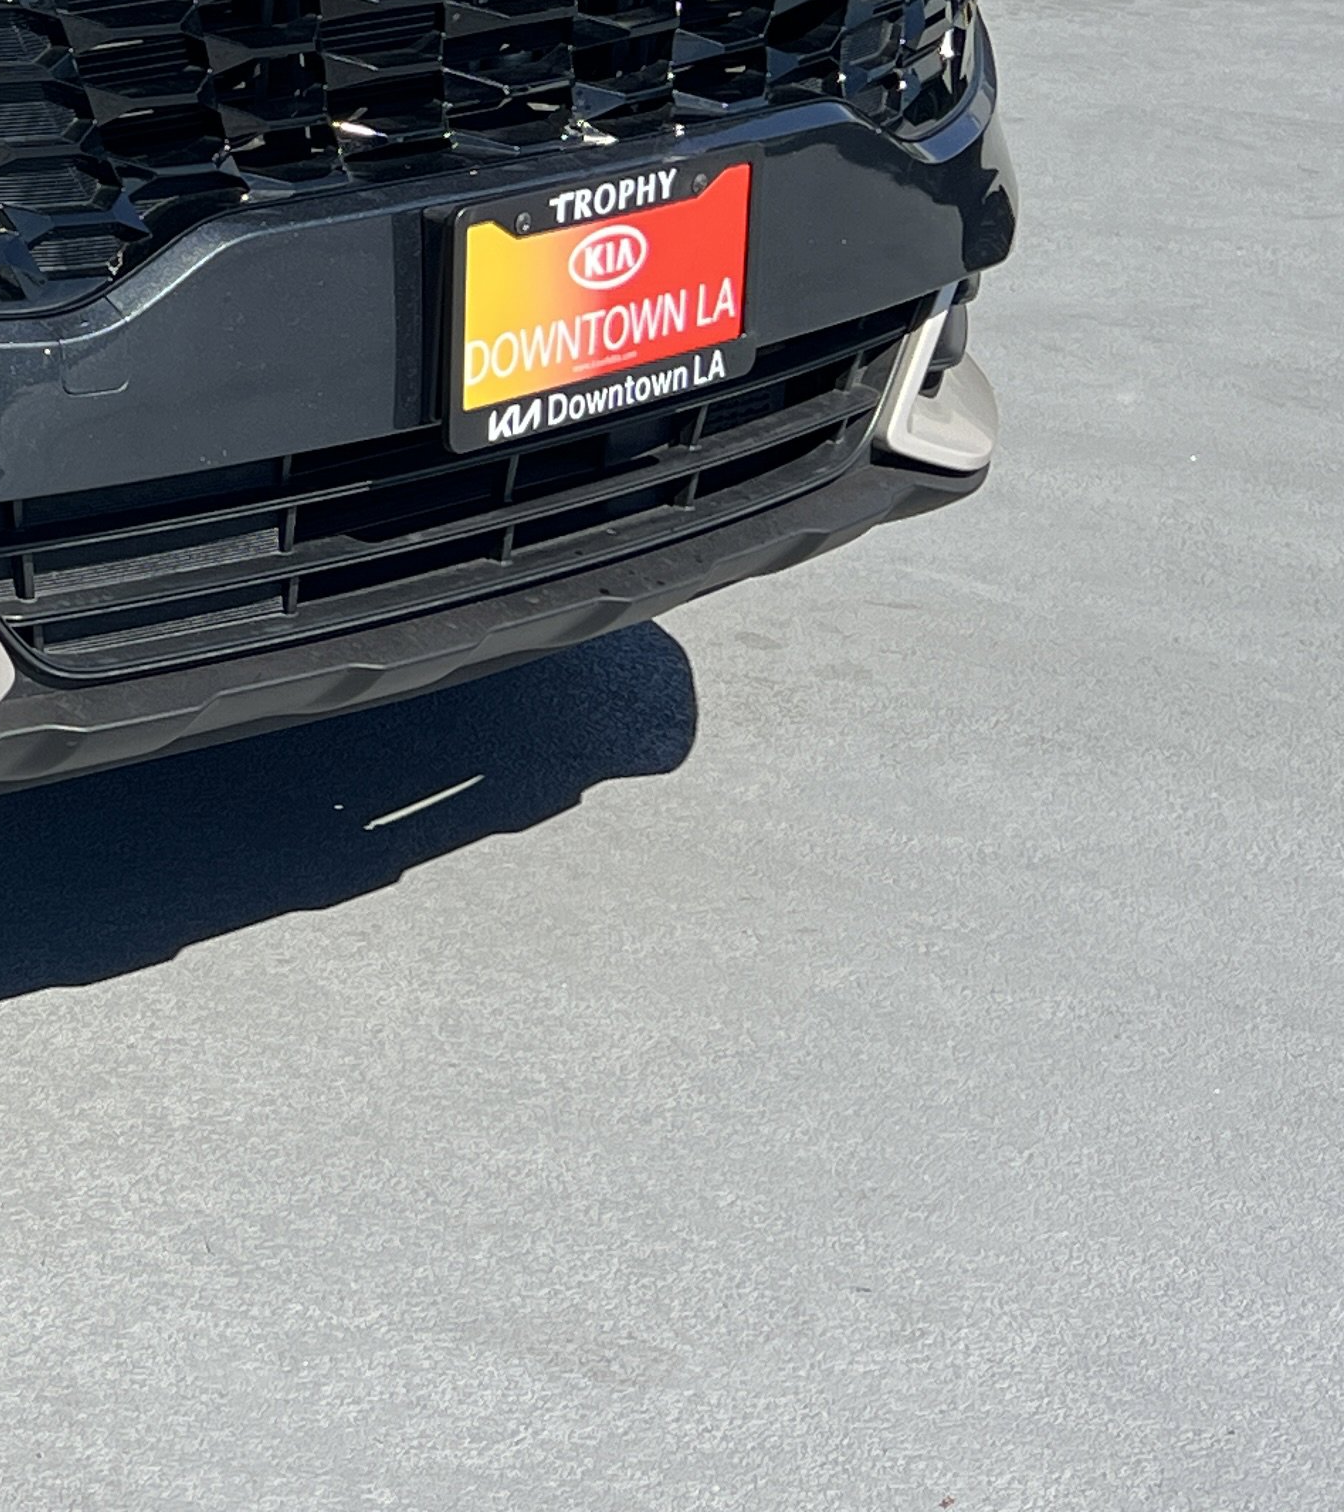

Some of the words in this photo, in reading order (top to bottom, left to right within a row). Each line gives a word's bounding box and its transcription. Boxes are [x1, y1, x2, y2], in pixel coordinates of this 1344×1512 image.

[548, 167, 679, 224] TROPHY
[583, 238, 638, 279] KIA
[465, 288, 688, 387] DOWNTOWN
[696, 276, 737, 328] LA
[487, 397, 544, 442] KIA
[547, 364, 688, 427] Downtown
[692, 348, 727, 386] LA
